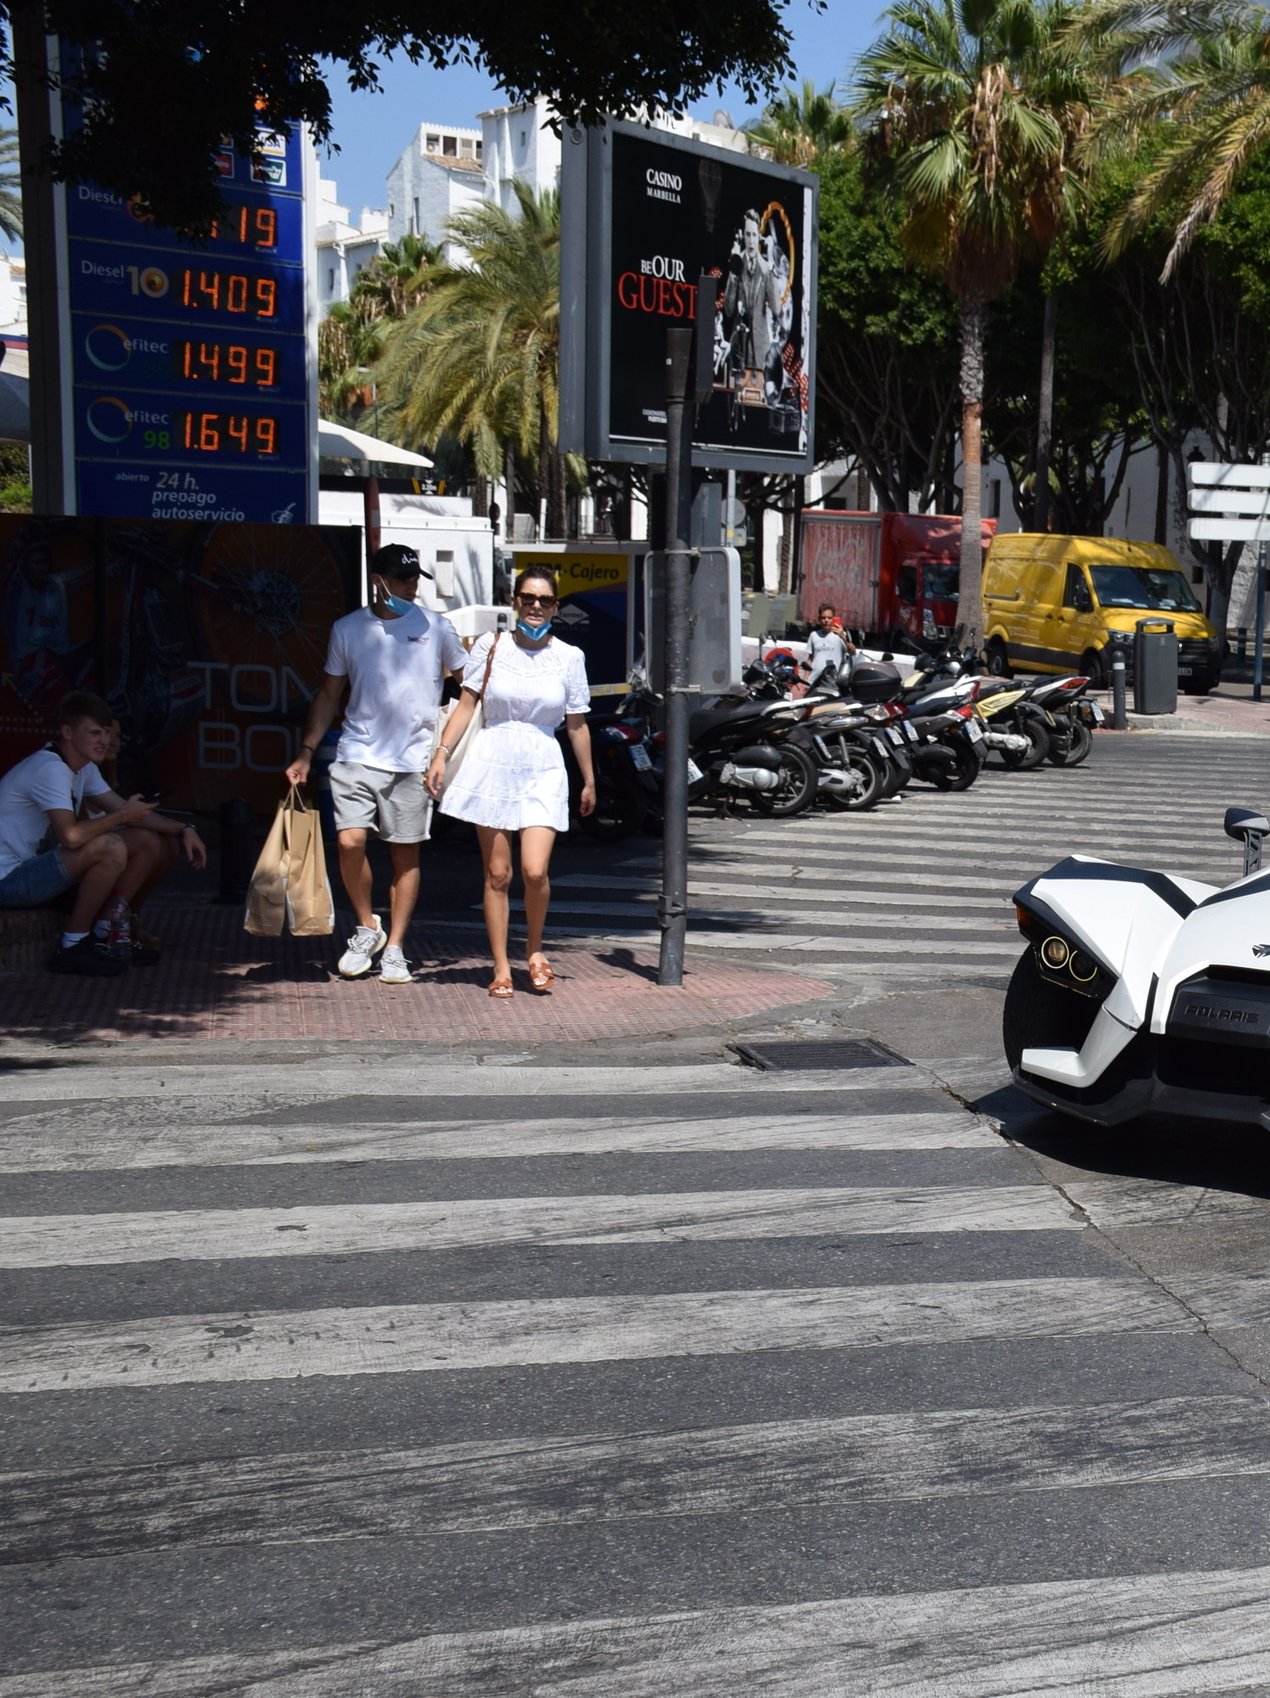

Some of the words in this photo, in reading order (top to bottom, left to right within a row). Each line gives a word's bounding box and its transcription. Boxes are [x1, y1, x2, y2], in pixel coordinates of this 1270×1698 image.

[646, 168, 682, 191] CASINO
[646, 186, 681, 204] MARBELLA
[81, 260, 124, 278] Diesel
[641, 259, 652, 275] BE
[652, 255, 686, 283] OUR
[183, 269, 276, 317] 1.409
[618, 272, 698, 319] GUEST
[123, 338, 169, 354] efitec
[183, 341, 276, 386] 1.499
[124, 410, 170, 425] efitec
[143, 430, 170, 450] 98
[184, 412, 276, 454] 1.649
[115, 472, 149, 482] abierto
[156, 471, 180, 489] 24
[184, 472, 199, 490] h.
[152, 490, 216, 507] prepago
[152, 507, 245, 522] autoservicio
[570, 563, 619, 581] Cajero
[1184, 1004, 1260, 1023] POLARIS
